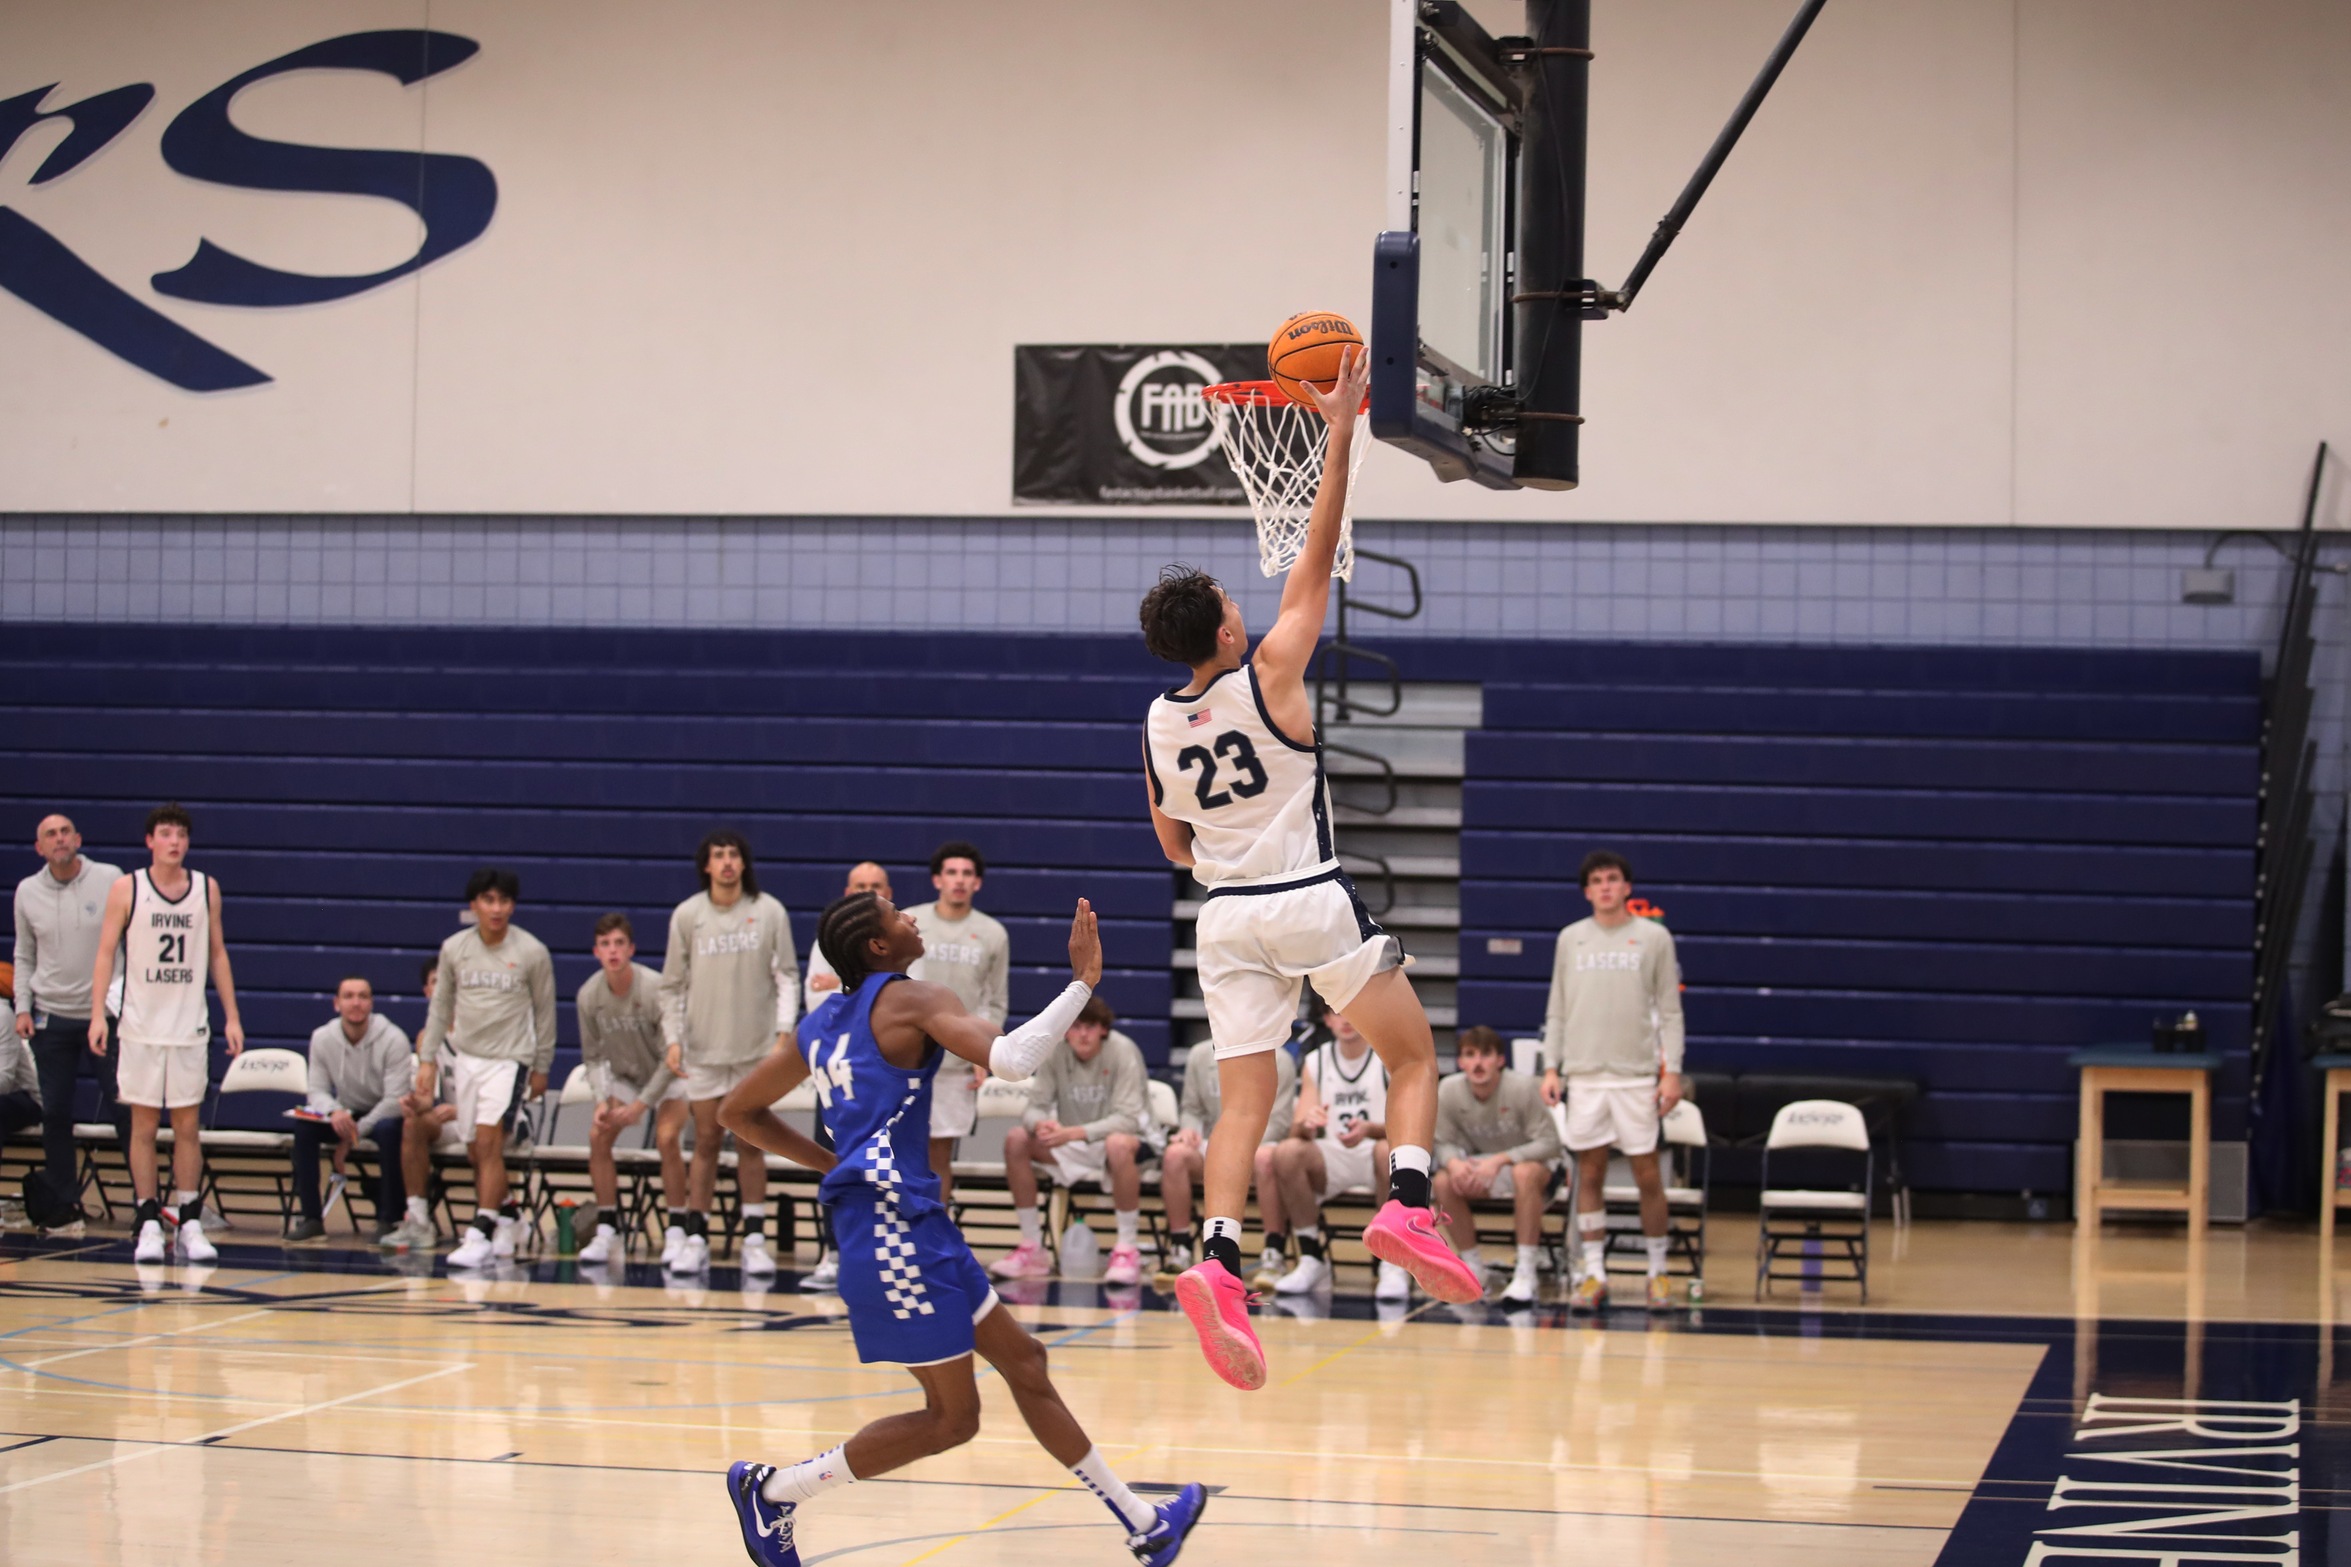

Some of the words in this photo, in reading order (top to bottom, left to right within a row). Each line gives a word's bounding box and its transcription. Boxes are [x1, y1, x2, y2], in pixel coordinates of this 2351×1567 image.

[1287, 319, 1354, 340] Wilson
[1177, 729, 1269, 810] 23
[151, 913, 194, 928] IRVINE
[158, 934, 185, 963] 21
[697, 930, 760, 956] LASERS
[927, 943, 982, 966] ASERS
[1575, 951, 1640, 972] LASERS
[146, 968, 194, 984] LASERS
